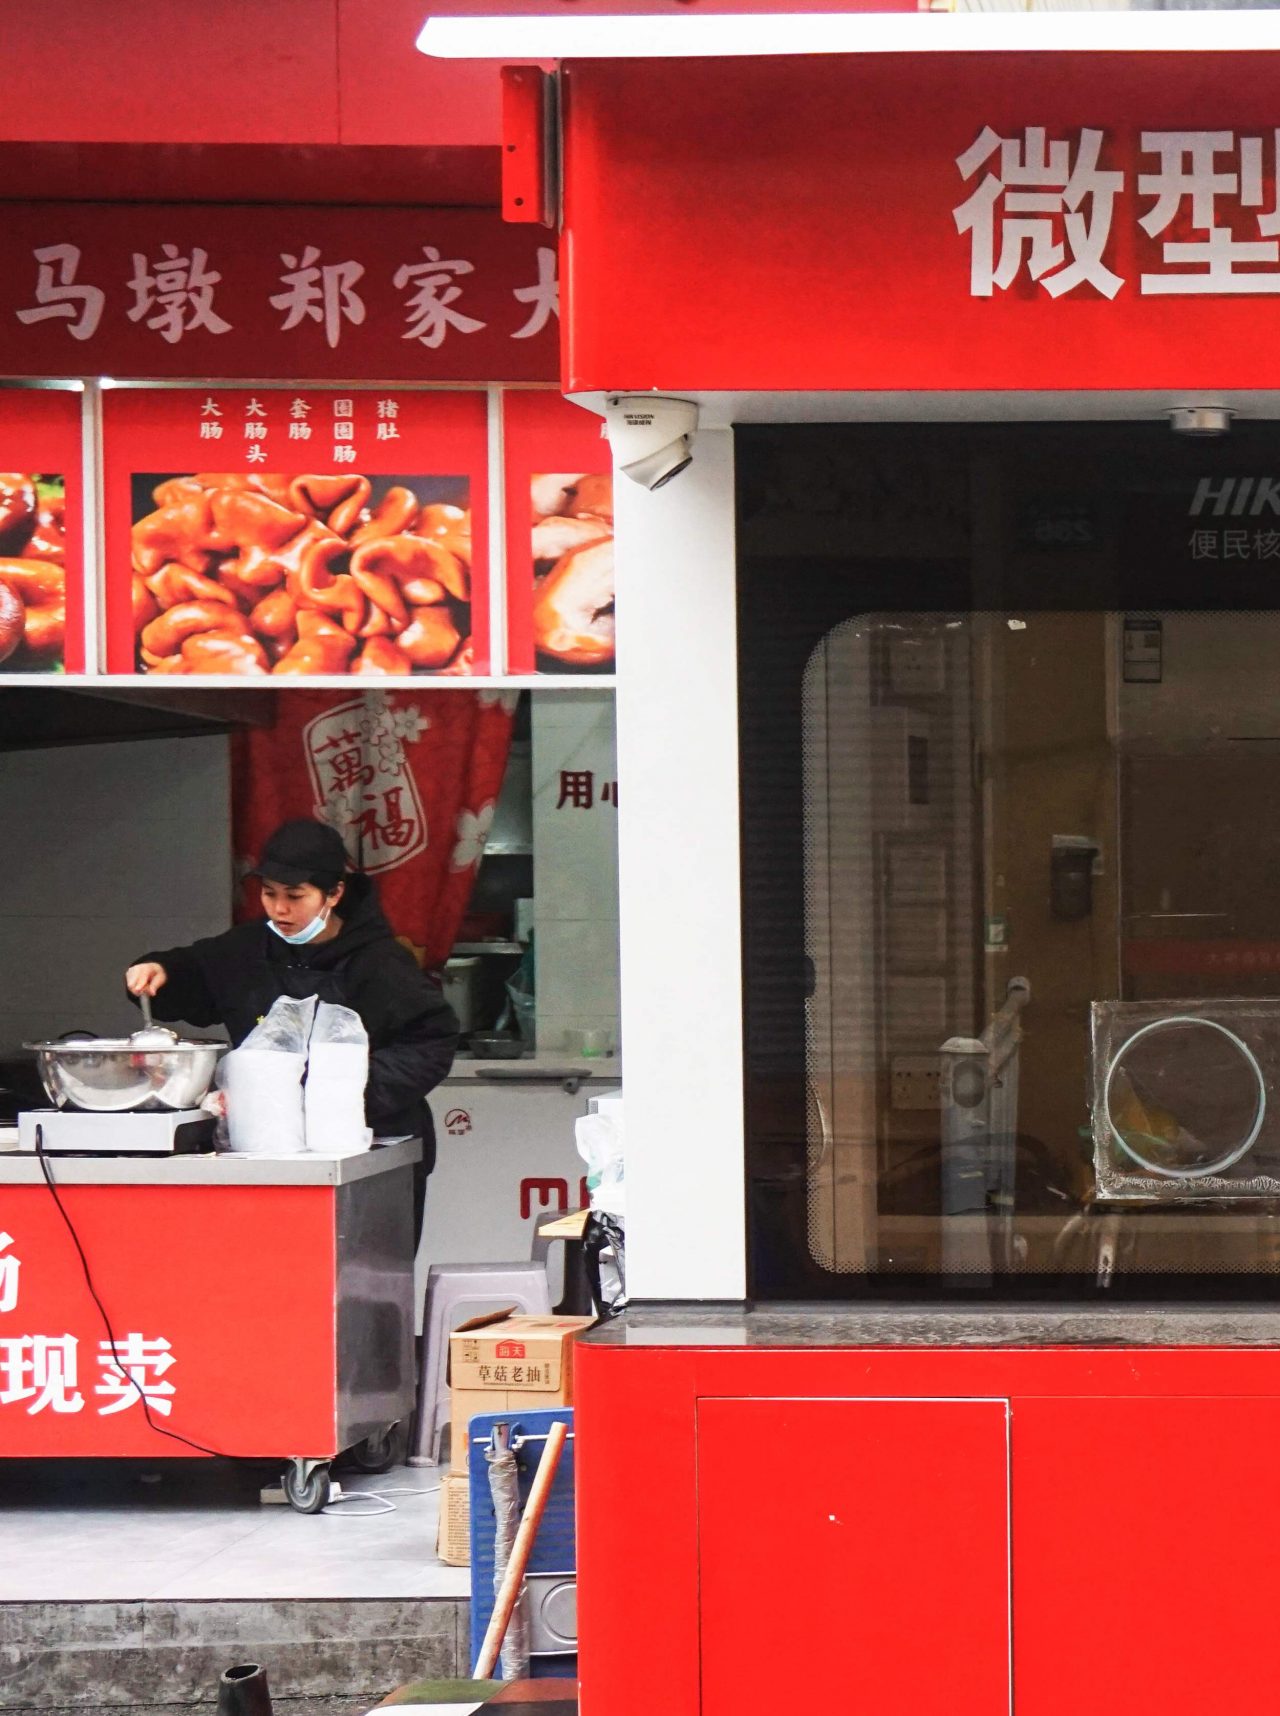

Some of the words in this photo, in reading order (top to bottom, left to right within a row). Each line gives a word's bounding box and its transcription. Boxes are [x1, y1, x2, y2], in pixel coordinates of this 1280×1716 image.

[201, 398, 223, 440] 大肠
[244, 398, 268, 463] 大肠头
[289, 398, 312, 440] 套肠
[376, 398, 400, 440] 猪肚
[313, 729, 414, 850] 萬福
[479, 1365, 541, 1383] 草菇老抽
